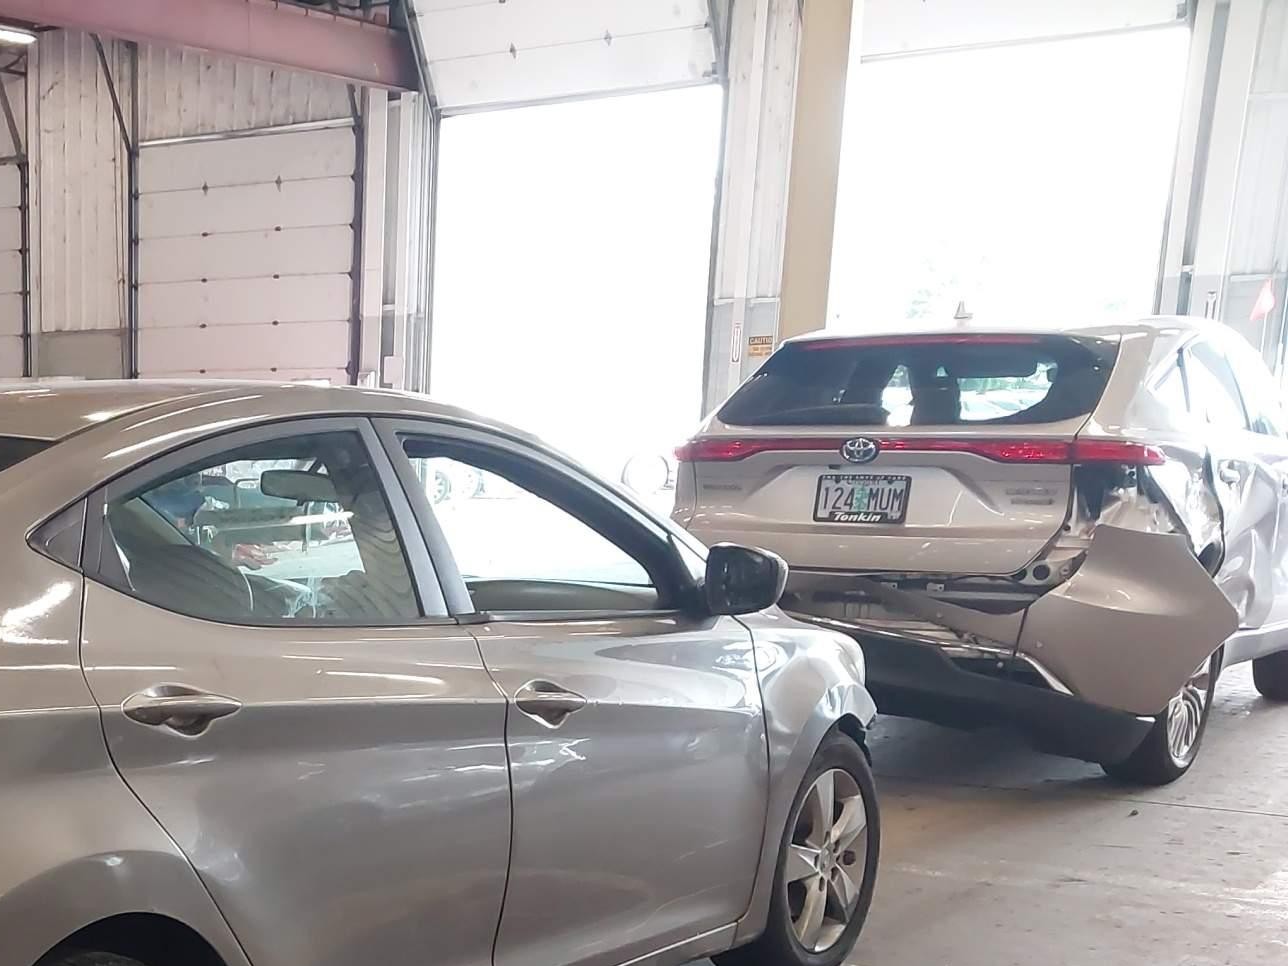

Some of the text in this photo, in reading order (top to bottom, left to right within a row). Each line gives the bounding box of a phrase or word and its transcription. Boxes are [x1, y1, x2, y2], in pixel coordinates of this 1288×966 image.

[749, 336, 773, 345] CAUTIO
[822, 487, 904, 512] 124 MUM
[833, 511, 882, 522] Tonkin
